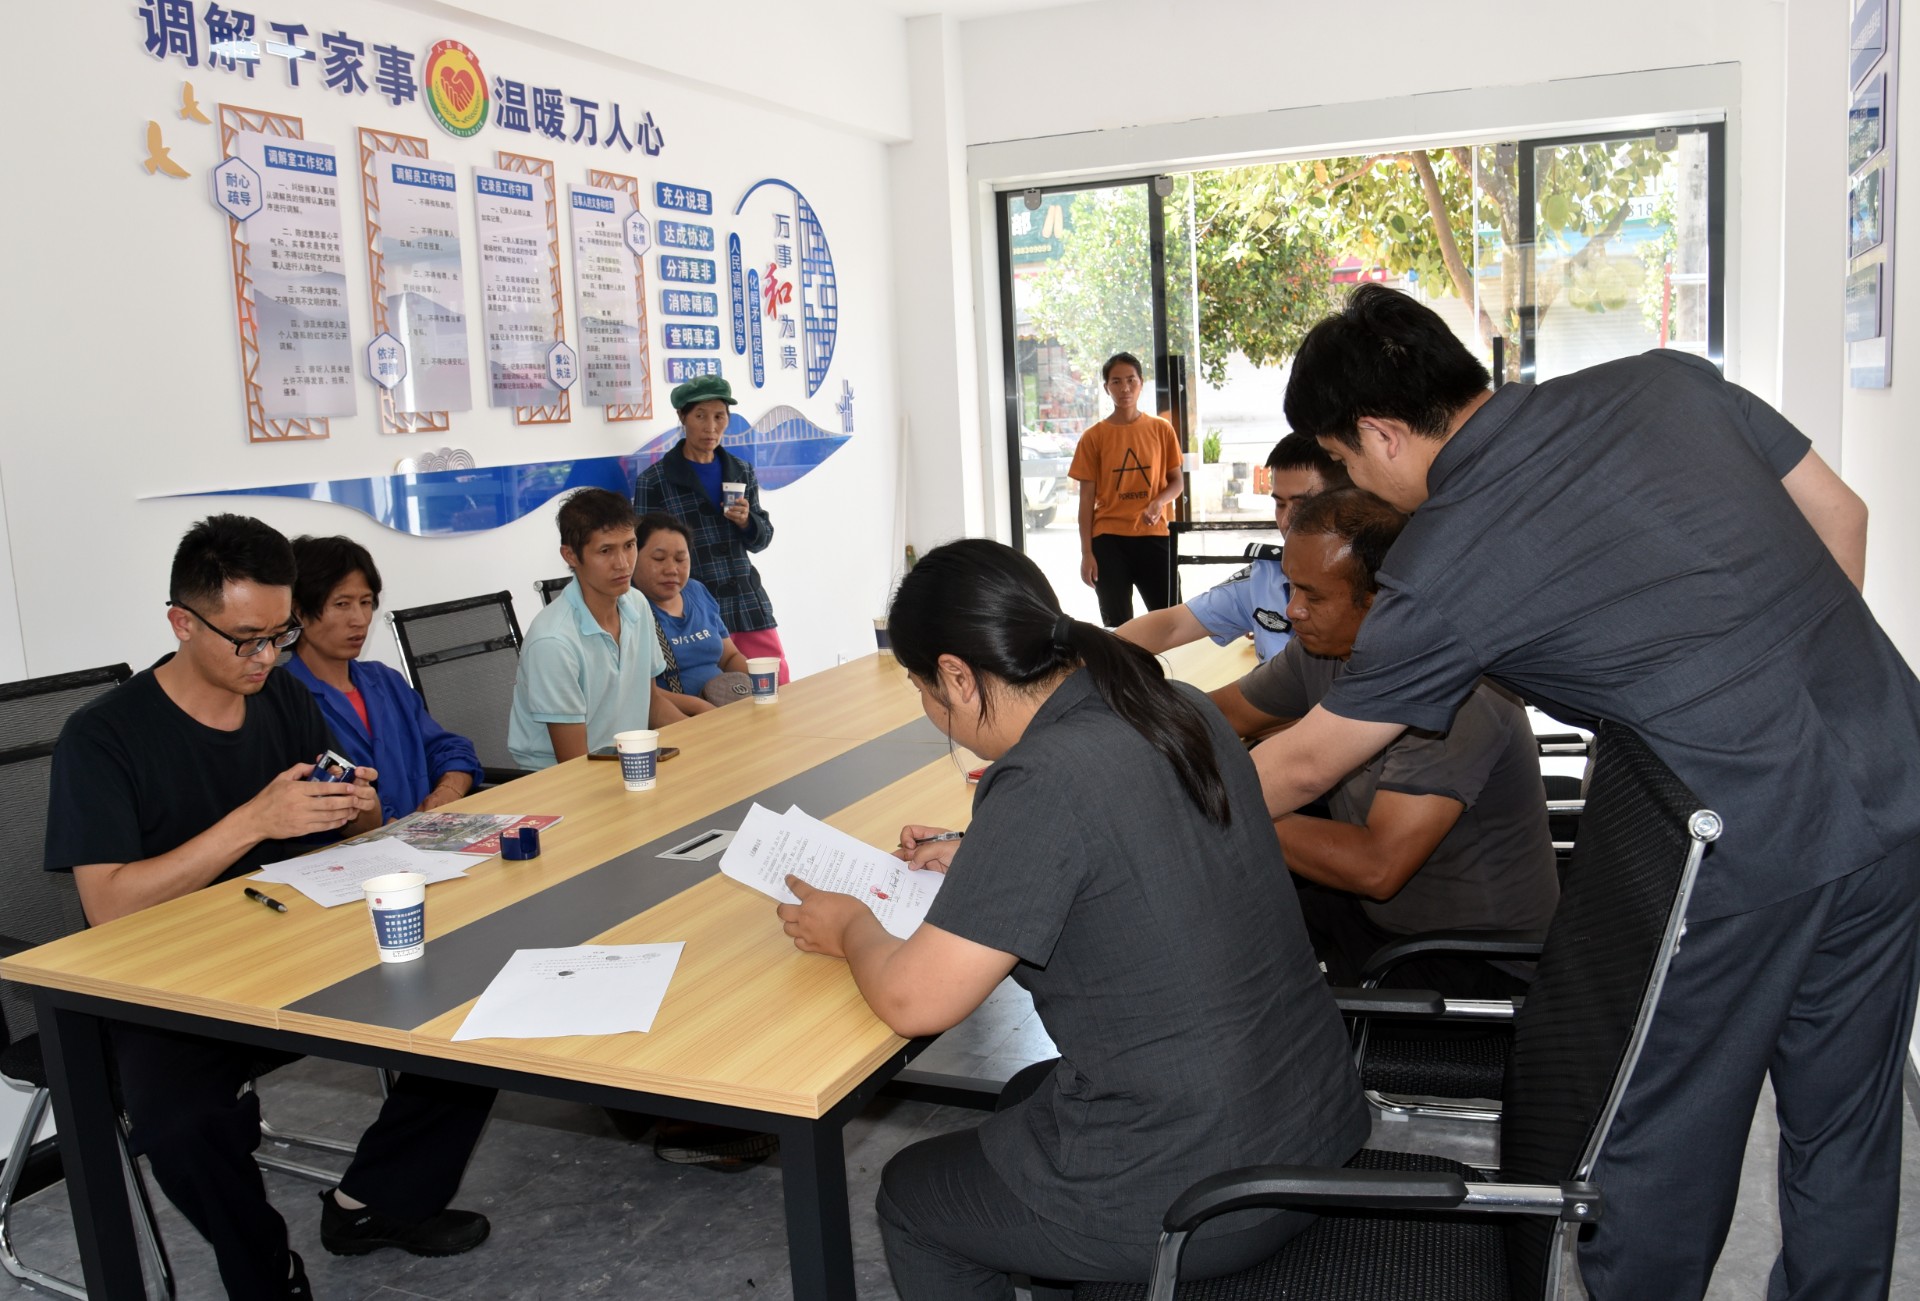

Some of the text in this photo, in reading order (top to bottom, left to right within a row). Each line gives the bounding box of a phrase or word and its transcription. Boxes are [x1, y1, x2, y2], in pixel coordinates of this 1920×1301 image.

[138, 0, 418, 105] 调解千家事
[493, 75, 665, 157] 温暖万人心
[268, 148, 334, 173] 调解室工作纪律
[226, 172, 251, 190] 耐心
[396, 167, 454, 188] 调解员工作守则
[480, 178, 529, 198] 记录员工作守则
[228, 189, 251, 207] 疏导
[662, 186, 708, 211] 充分说理
[664, 224, 710, 248] 达成协议
[666, 259, 712, 280] 分清是非
[730, 238, 744, 349] 人民调解息纷争
[764, 213, 798, 370] 万事和为贵
[668, 293, 713, 314] 消除隔阂
[670, 328, 715, 346] 查明事实
[749, 274, 764, 384] 化解矛盾促和谐
[377, 347, 397, 361] 依法
[556, 354, 570, 366] 秉公
[556, 366, 570, 379] 执法
[1112, 448, 1152, 491] A
[1118, 491, 1148, 500] FOREVER
